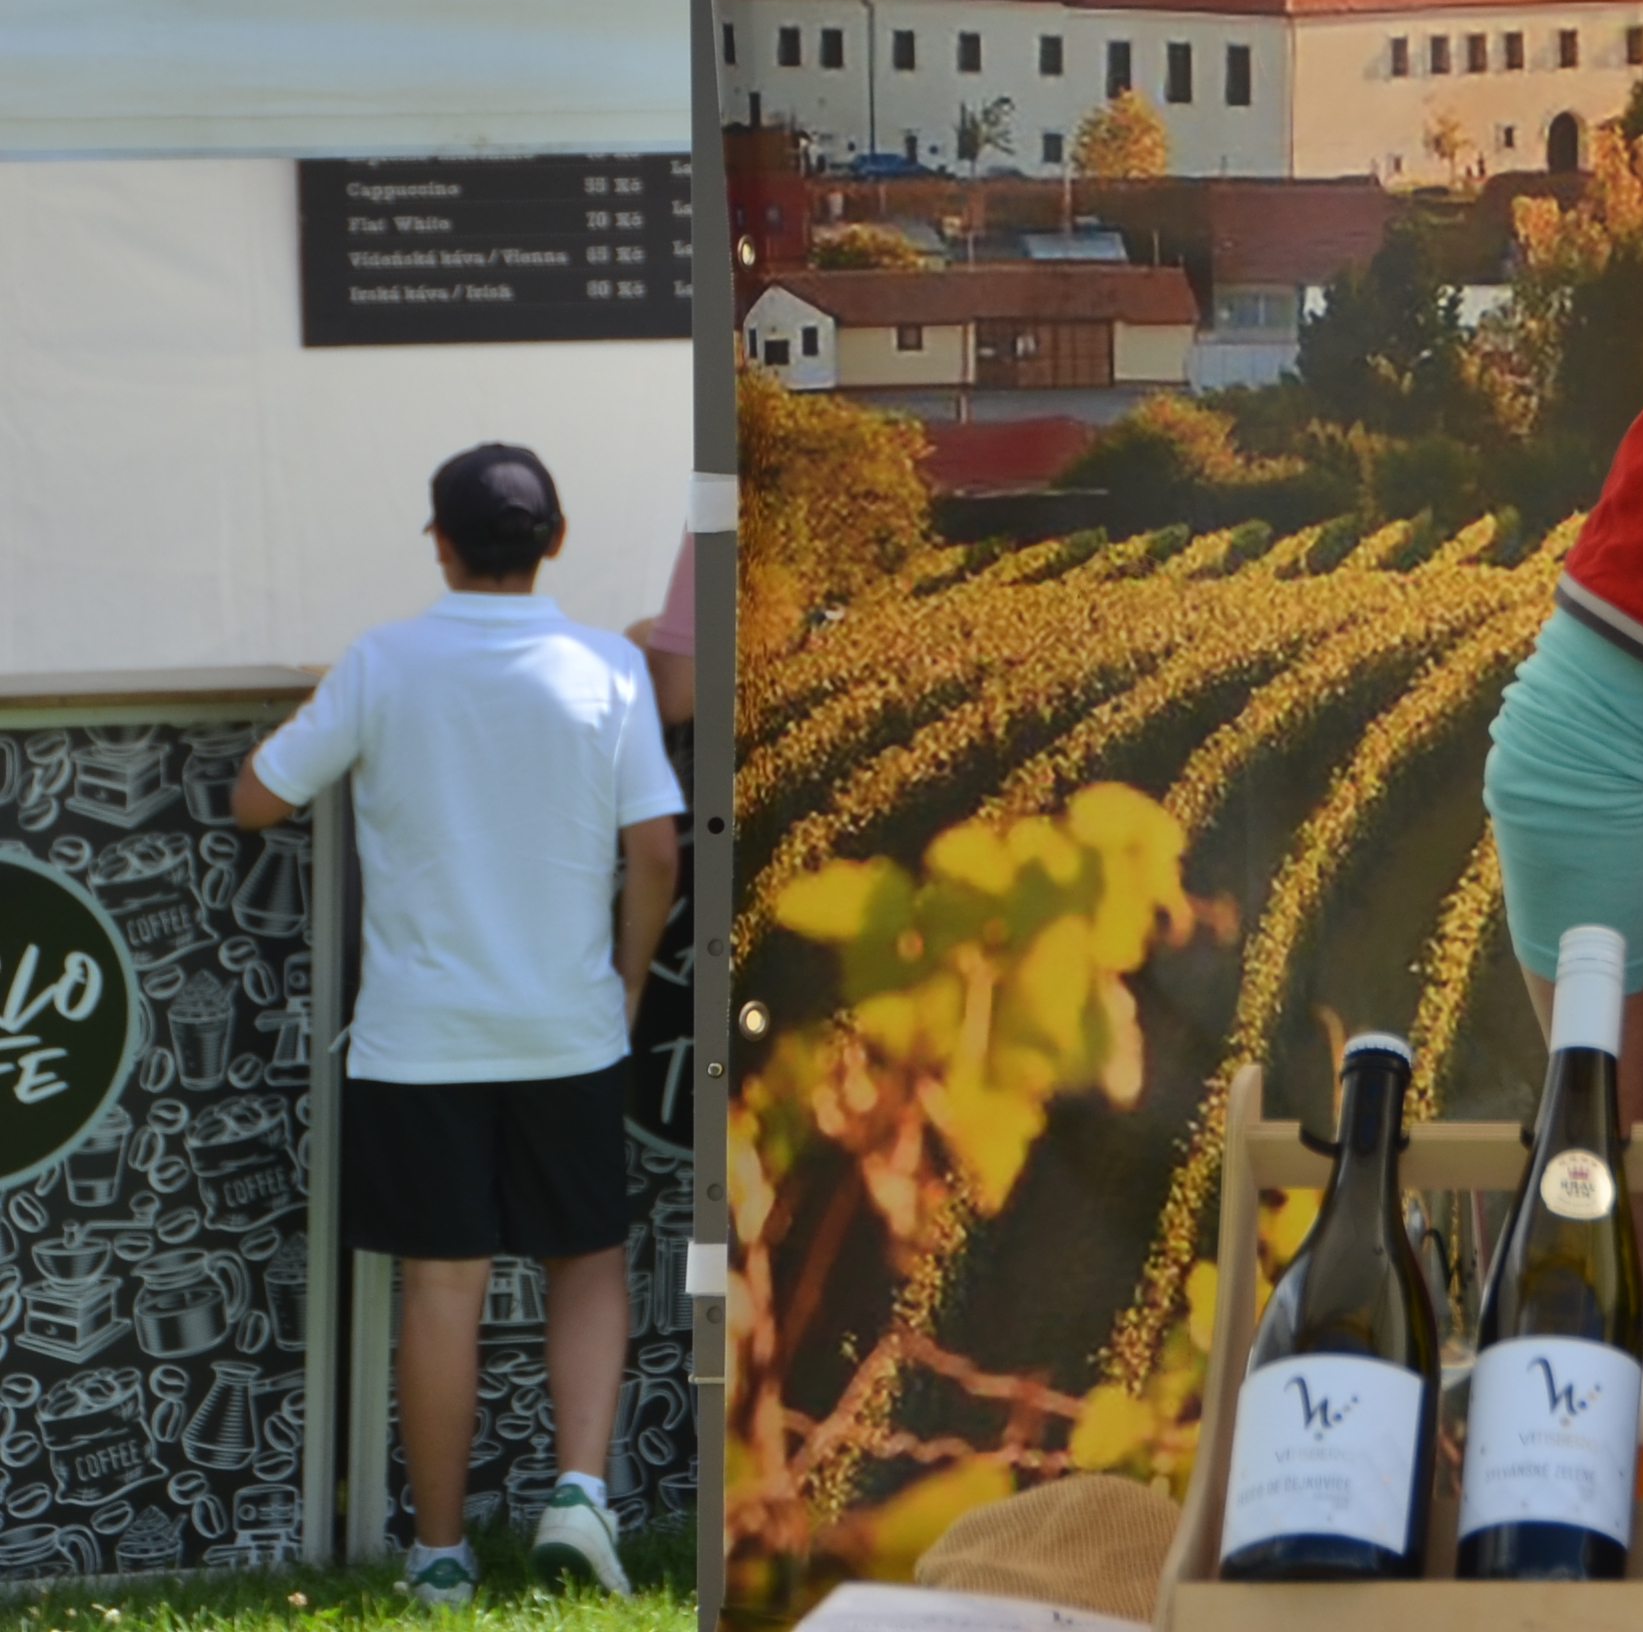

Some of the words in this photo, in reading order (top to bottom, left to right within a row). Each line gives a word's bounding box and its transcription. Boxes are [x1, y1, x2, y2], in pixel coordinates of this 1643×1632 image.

[346, 181, 461, 203] Cappuccino
[348, 217, 387, 235] Flat
[393, 216, 453, 234] White
[500, 248, 570, 266] Vienna
[126, 905, 195, 947] COFFEE
[0, 943, 103, 1034] LO
[223, 1169, 290, 1208] COFFEE
[75, 1439, 143, 1482] COFFEE
